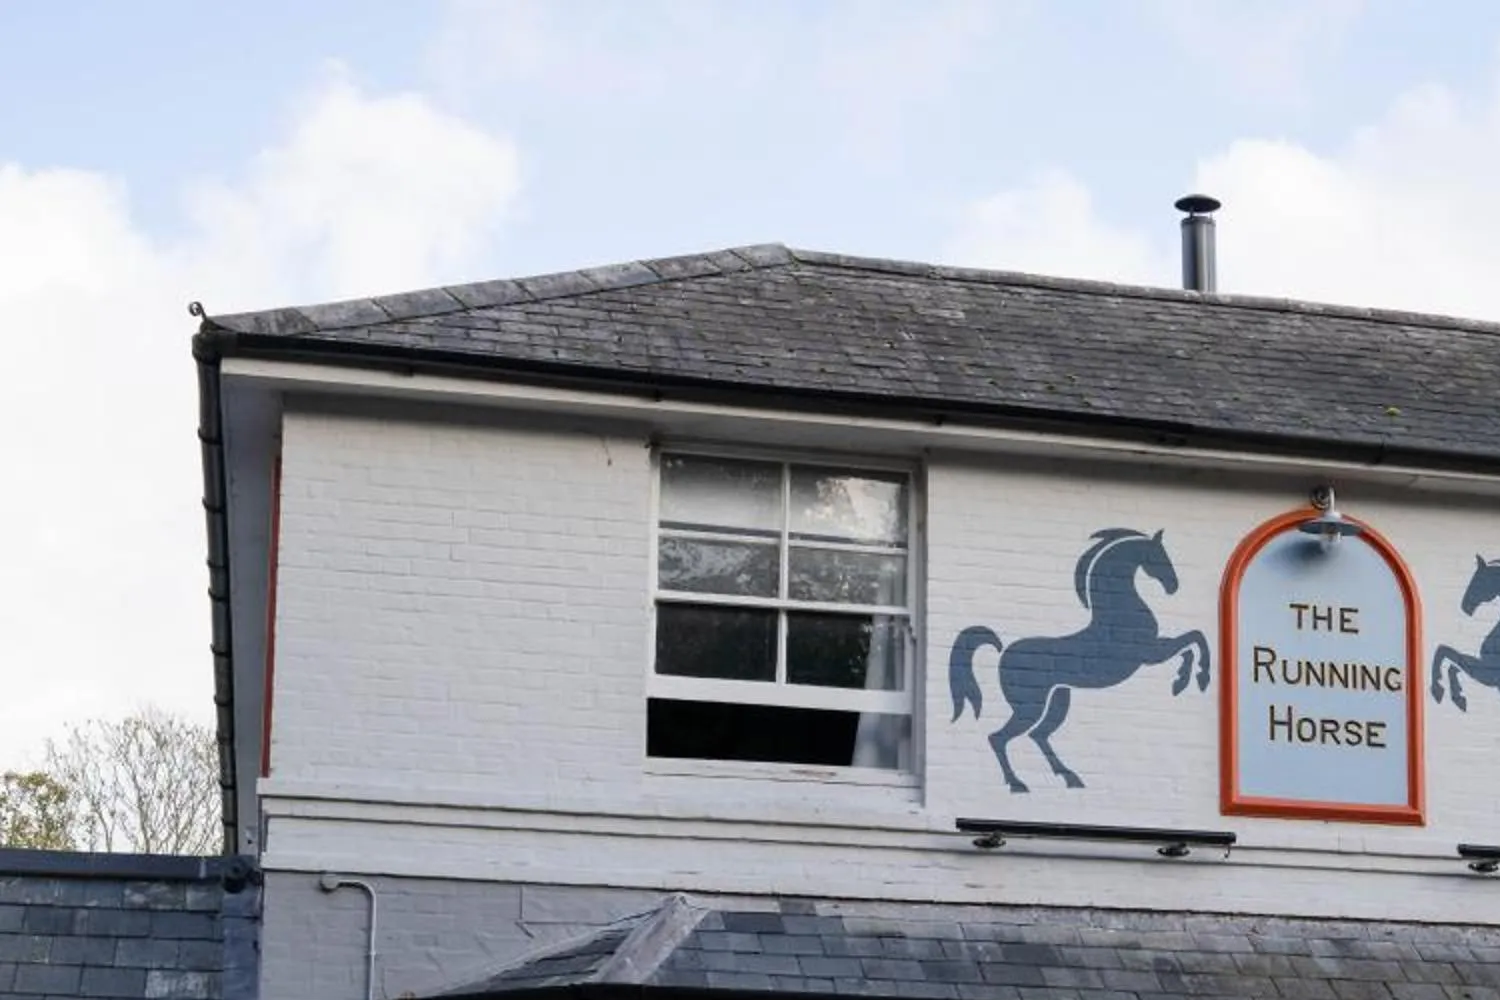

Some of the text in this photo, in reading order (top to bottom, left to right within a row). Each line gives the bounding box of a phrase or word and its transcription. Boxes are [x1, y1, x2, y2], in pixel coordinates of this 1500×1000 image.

[1290, 603, 1359, 633] THE
[1253, 645, 1402, 692] RUNNING
[1269, 704, 1387, 748] HORSE
